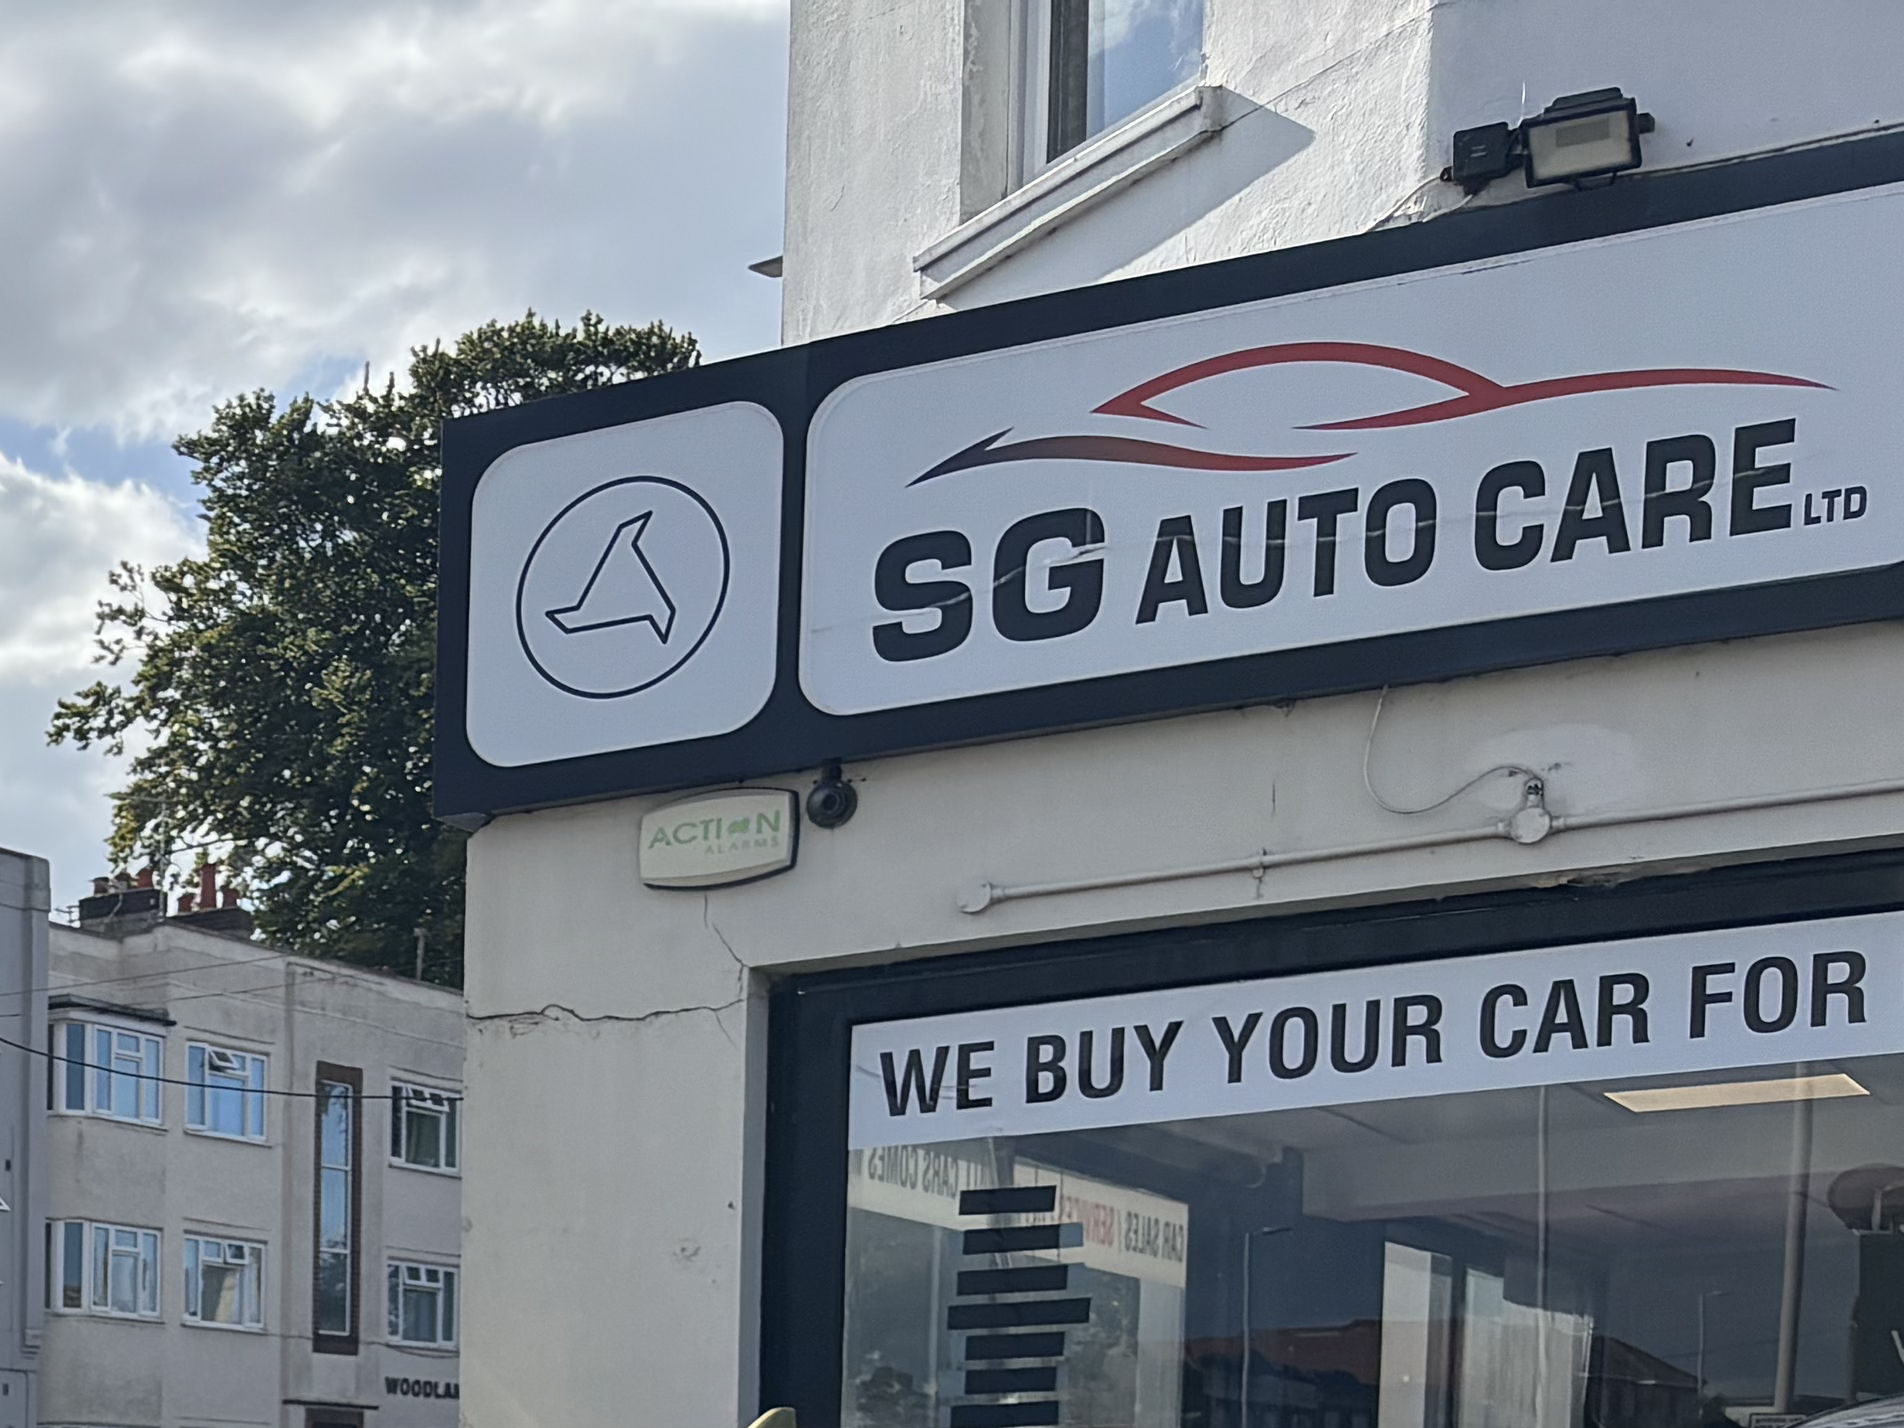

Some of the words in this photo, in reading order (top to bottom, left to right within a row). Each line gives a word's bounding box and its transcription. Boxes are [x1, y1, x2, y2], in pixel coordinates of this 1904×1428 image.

[872, 507, 1106, 663] SG
[1133, 478, 1438, 625] AUTO
[1473, 417, 1797, 570] CARE
[1800, 484, 1868, 526] LTD
[879, 1039, 996, 1117] WE
[1025, 1018, 1185, 1106] BUY
[1211, 992, 1447, 1086] YOUR
[1478, 971, 1653, 1060] CAR
[1688, 948, 1869, 1041] FOR
